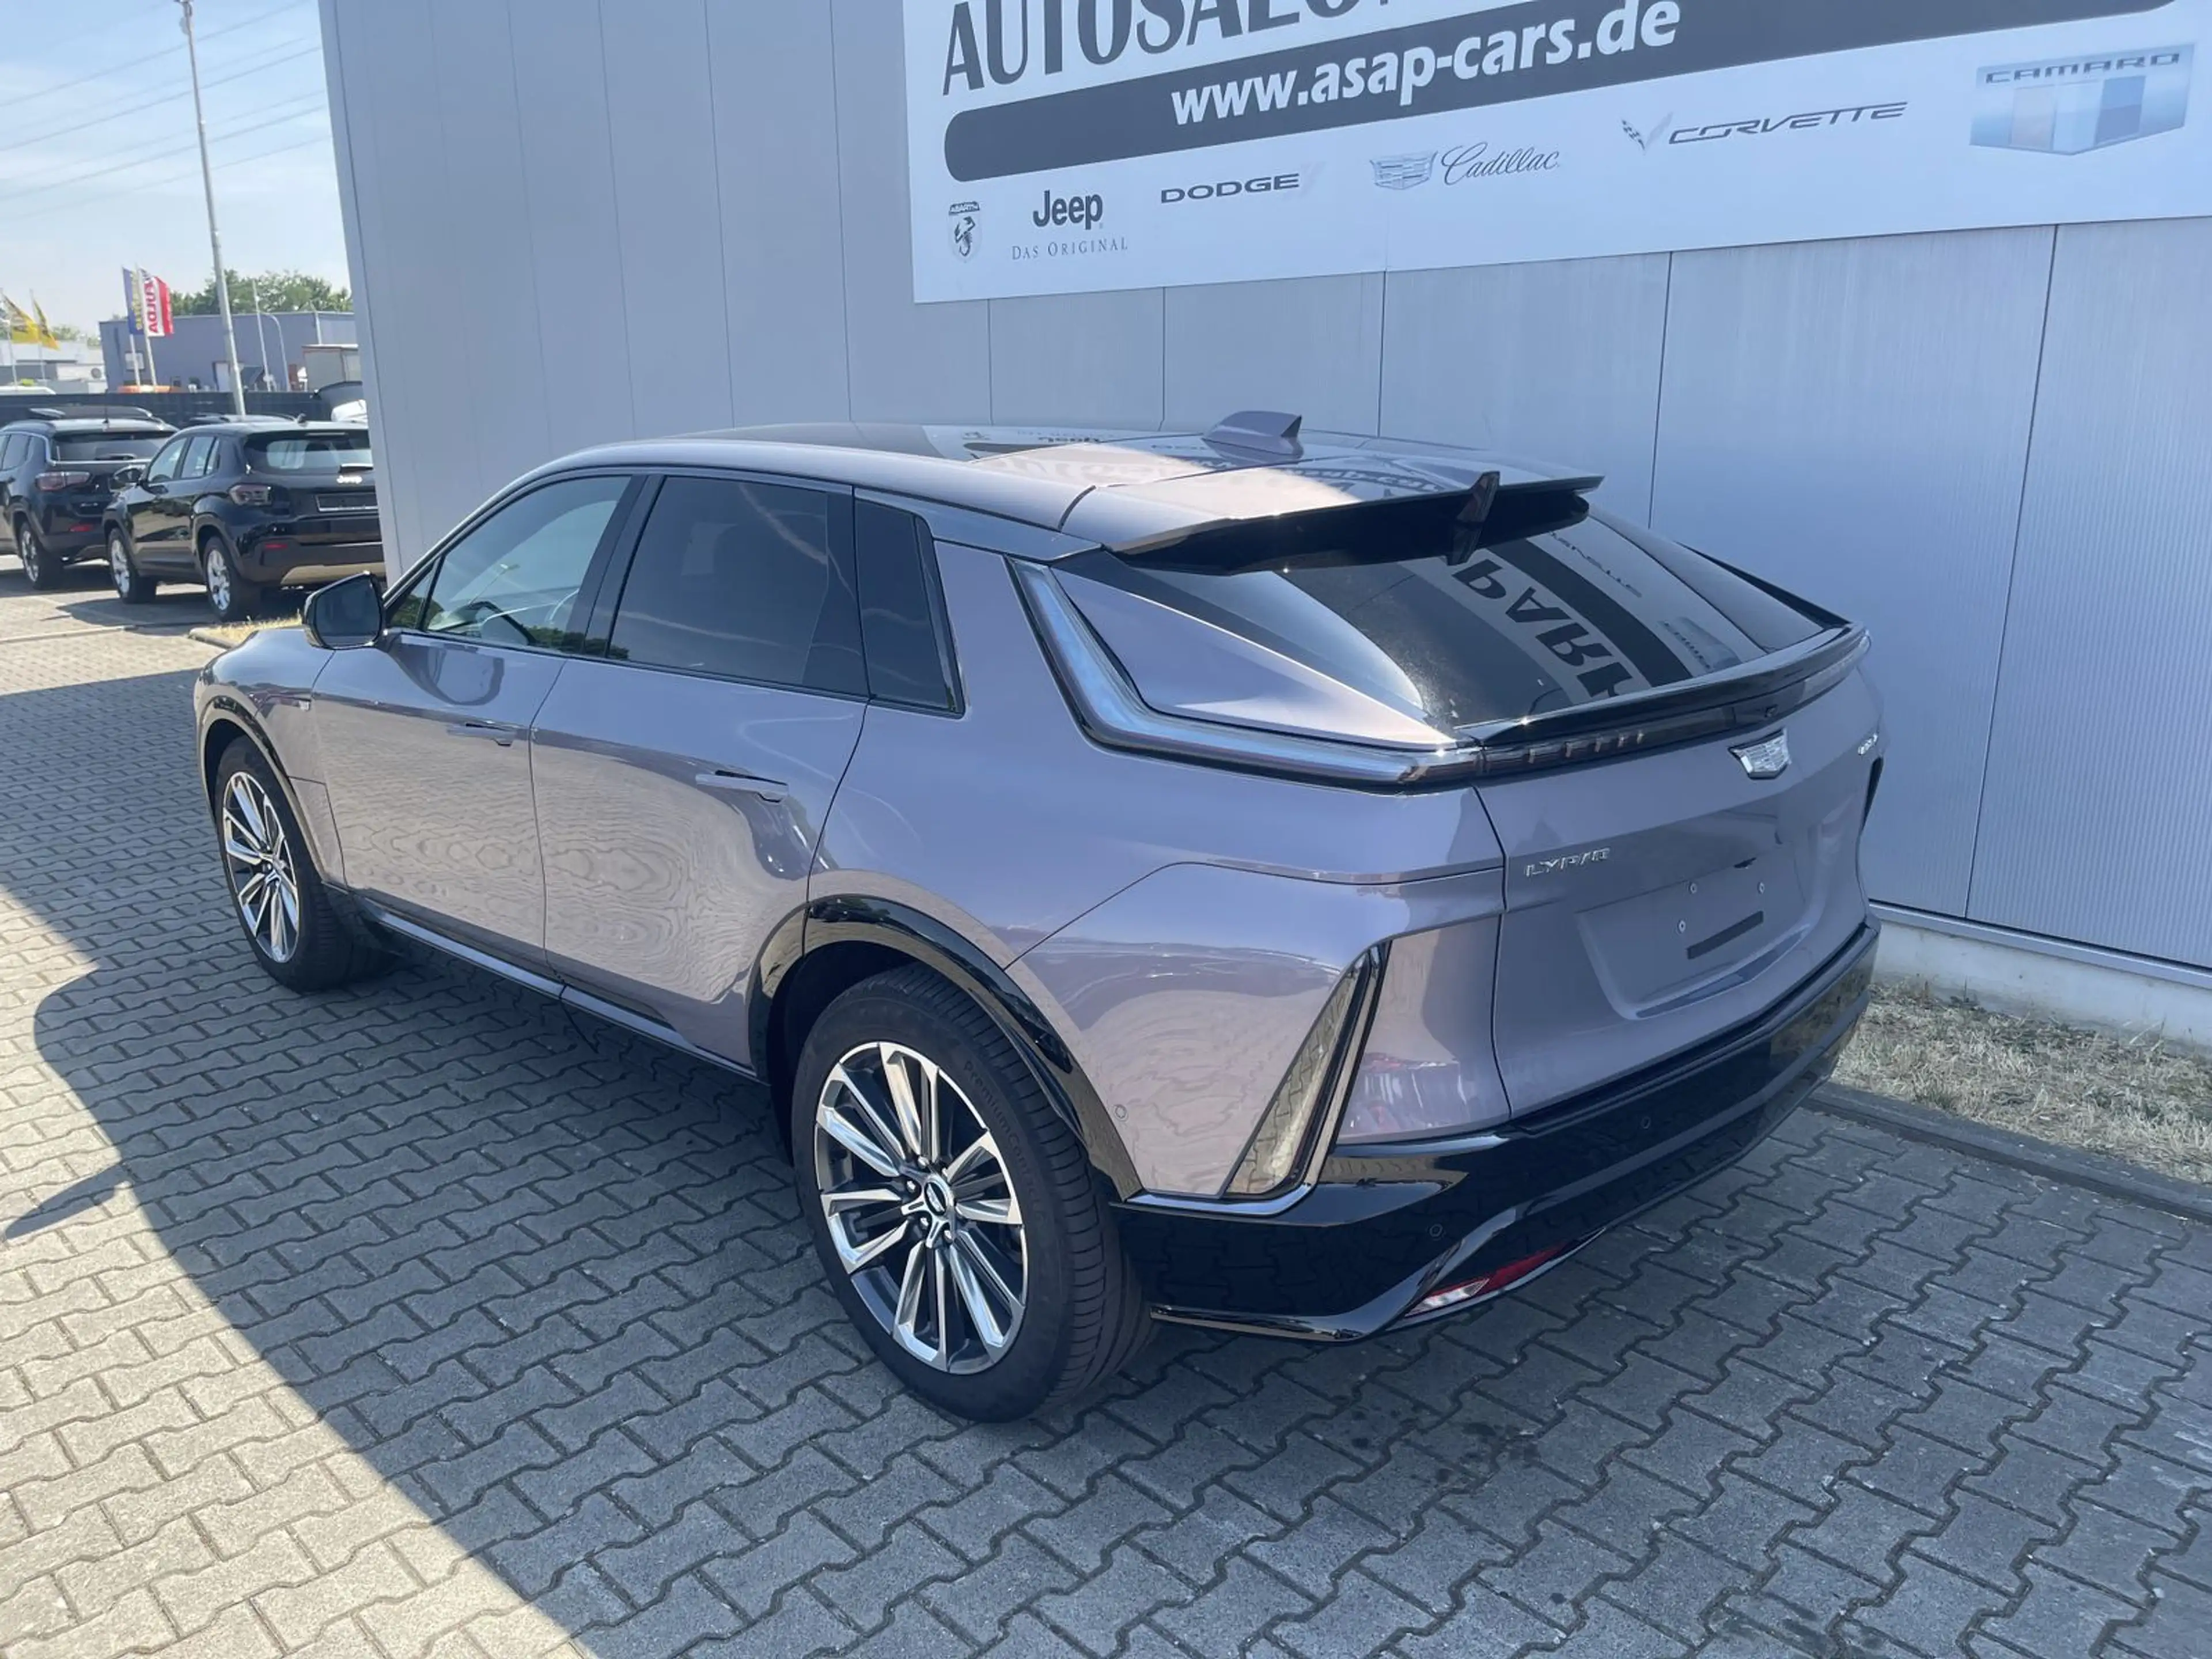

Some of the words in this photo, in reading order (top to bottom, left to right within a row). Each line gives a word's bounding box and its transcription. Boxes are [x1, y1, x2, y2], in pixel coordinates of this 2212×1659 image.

[943, 0, 1391, 96] AUTOS
[1171, 0, 1680, 125] www.asap-cars.de
[1985, 53, 2180, 84] CAMARO
[1669, 101, 1908, 144] CORVETTE
[1441, 142, 1559, 185] Cadillac
[1033, 190, 1103, 230] Jeep
[1161, 173, 1300, 204] DODGE
